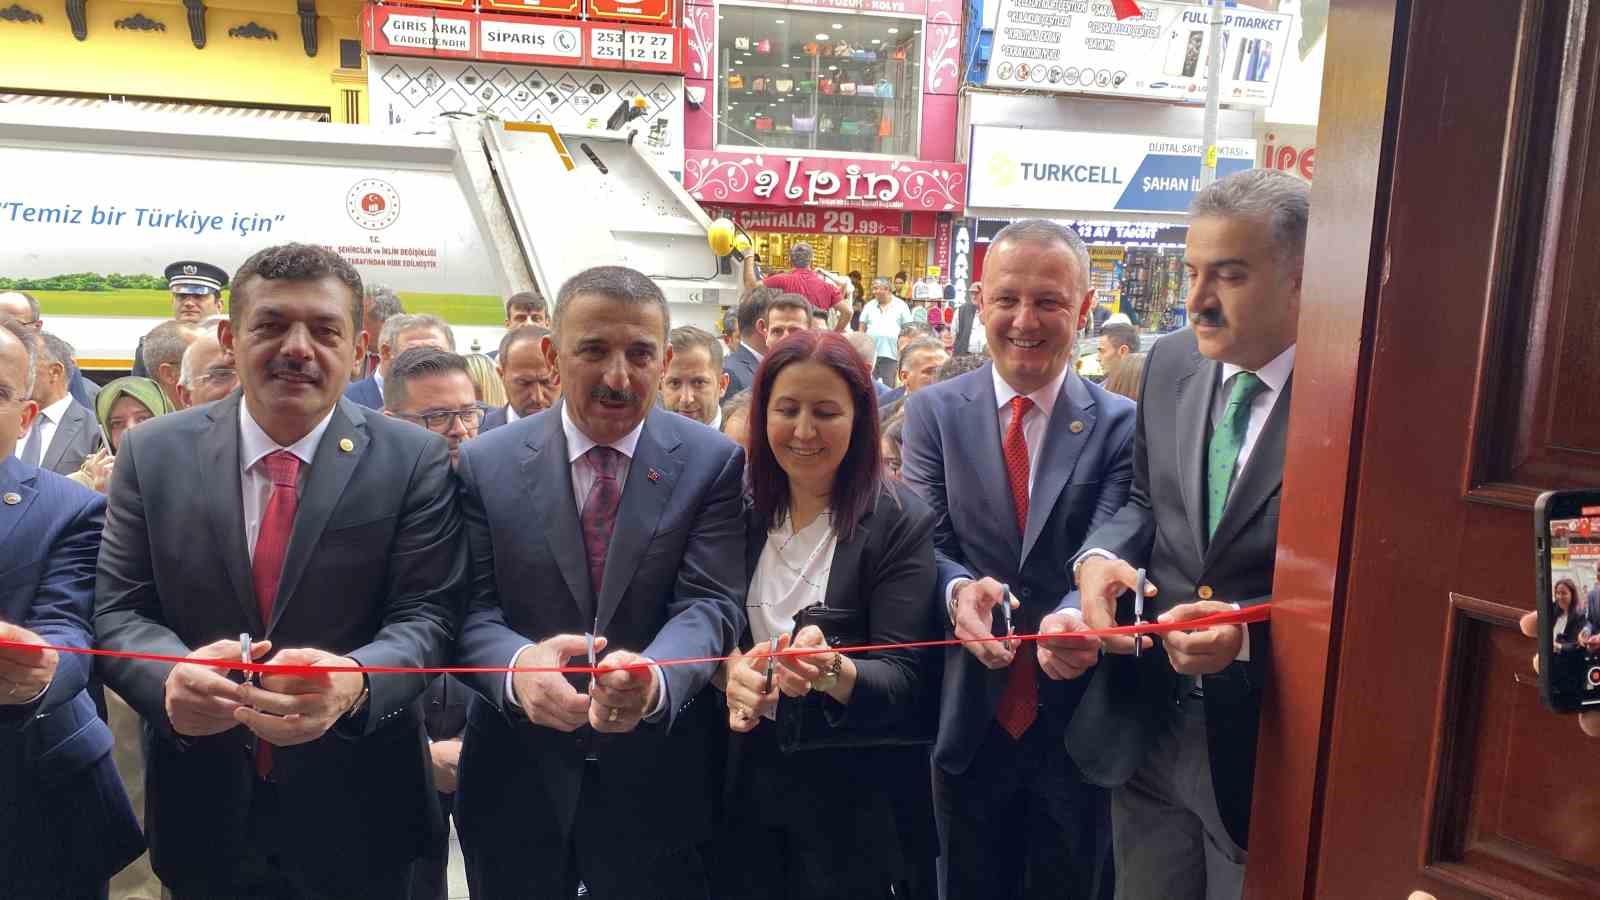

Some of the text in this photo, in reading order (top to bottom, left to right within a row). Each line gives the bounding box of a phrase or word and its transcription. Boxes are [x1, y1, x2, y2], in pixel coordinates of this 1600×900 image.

[432, 22, 466, 35] ARKA
[1234, 15, 1283, 31] MARKET
[487, 29, 545, 46] SİPARİŞ
[597, 32, 667, 47] 253 17 27
[597, 45, 668, 60] 251 12 12
[1181, 144, 1203, 154] SATI
[753, 157, 900, 205] alpin
[1020, 161, 1123, 185] TURKCELL
[1142, 176, 1201, 192] ŞAHAN İL
[91, 204, 127, 226] bir
[135, 208, 223, 235] Türkiye
